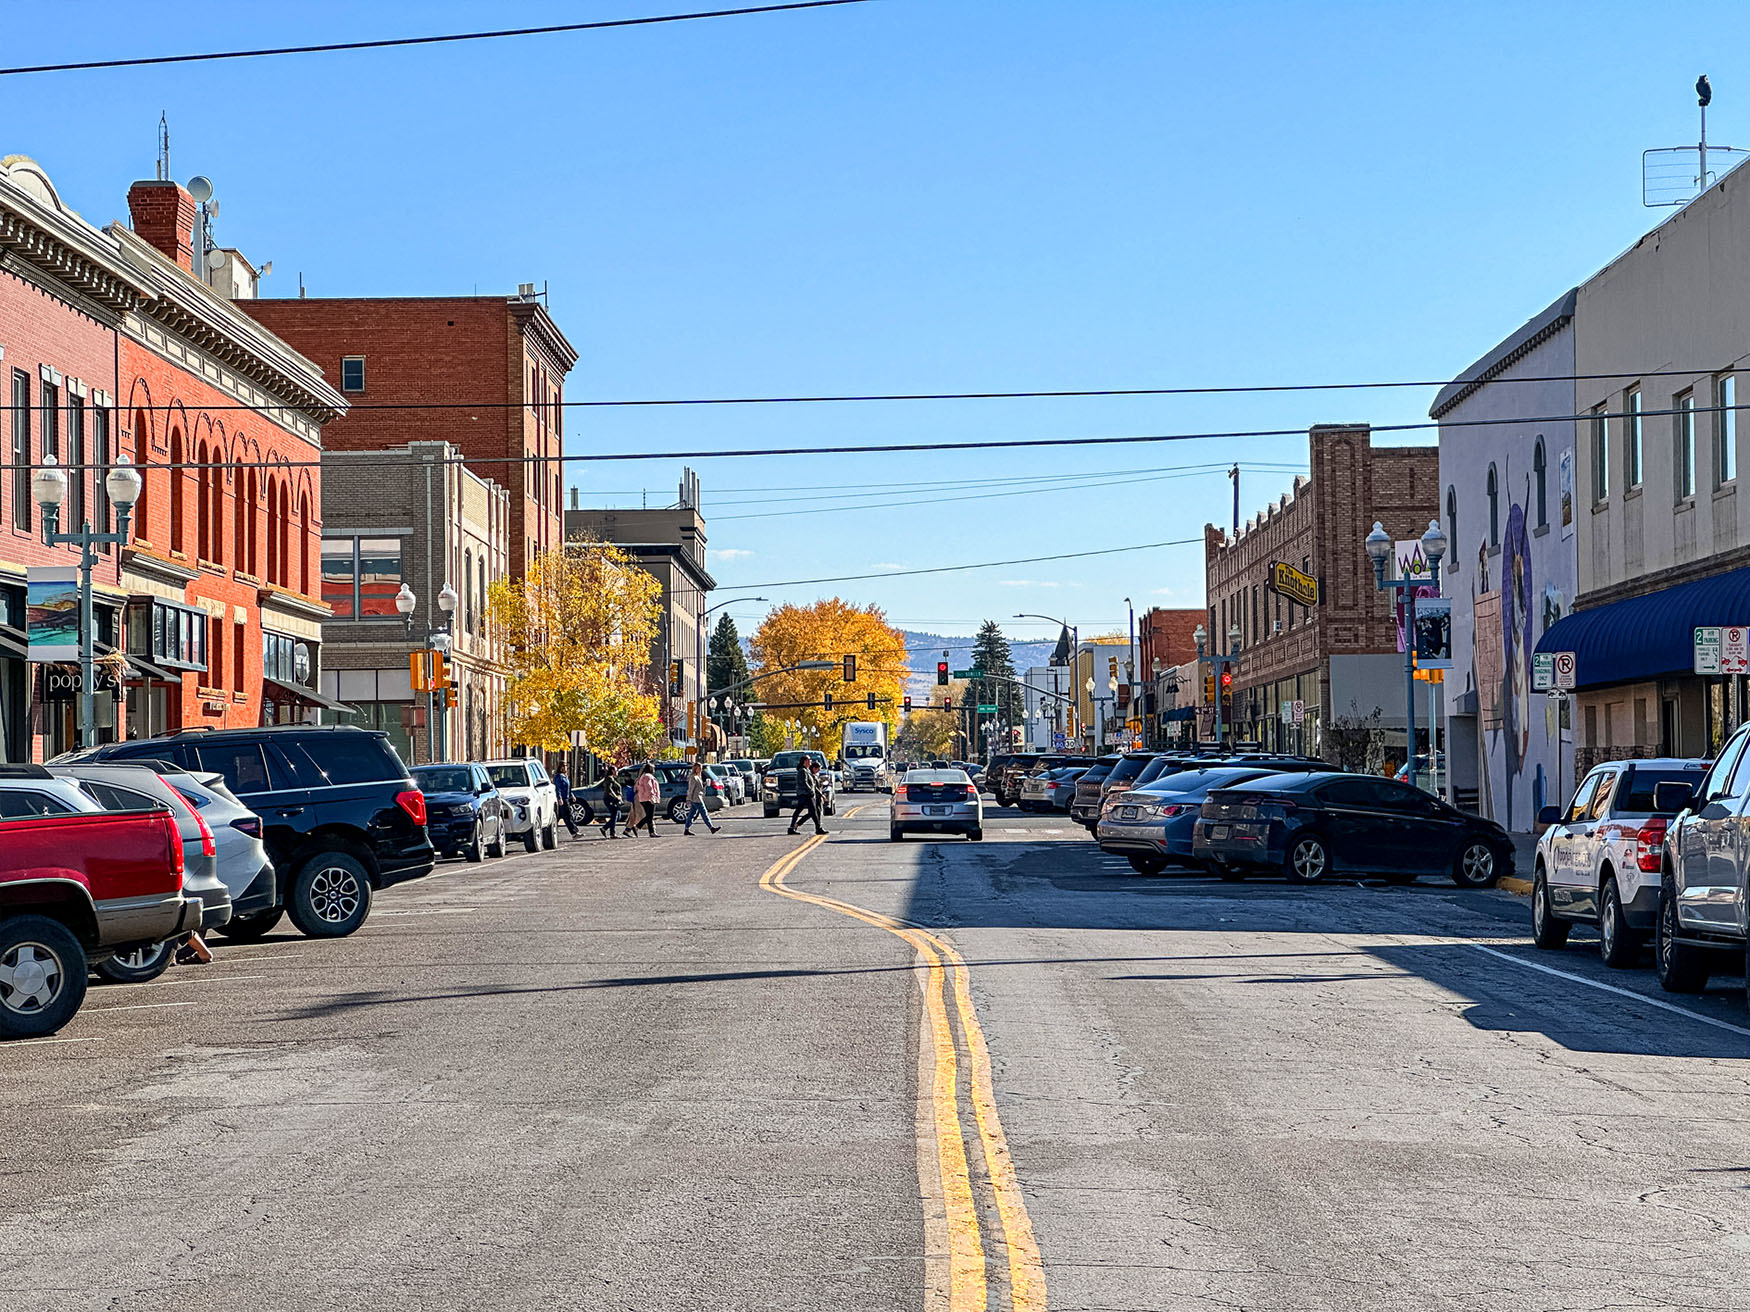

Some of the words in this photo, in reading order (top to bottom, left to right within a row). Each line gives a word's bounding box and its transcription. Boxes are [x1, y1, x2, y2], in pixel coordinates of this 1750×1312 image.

[1284, 565, 1294, 575] The
[1279, 569, 1315, 598] Knothole
[1696, 631, 1702, 643] 2
[1535, 655, 1540, 666] 2
[854, 727, 874, 735] Sysco
